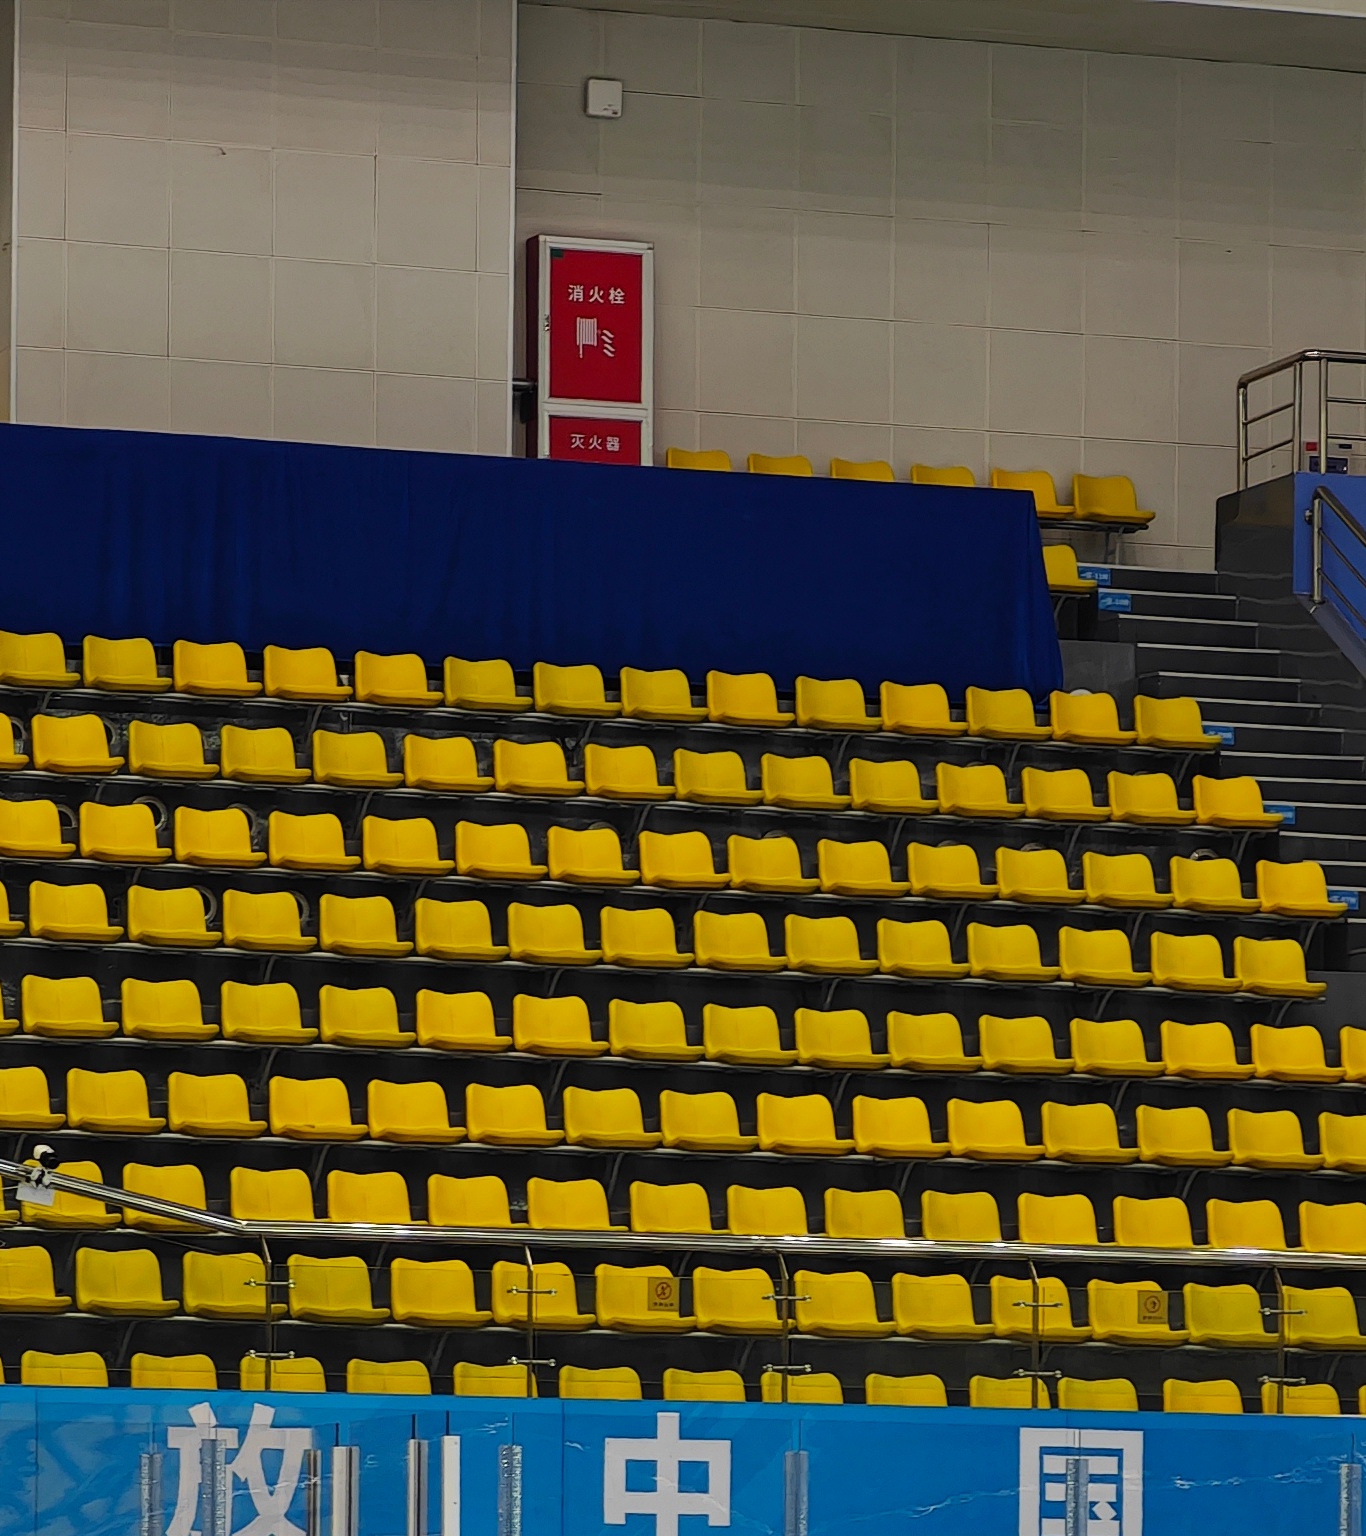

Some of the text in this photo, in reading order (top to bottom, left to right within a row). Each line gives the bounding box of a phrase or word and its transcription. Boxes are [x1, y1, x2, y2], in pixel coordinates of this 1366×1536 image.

[567, 284, 626, 305] 消火栓
[570, 433, 620, 452] 灭火器
